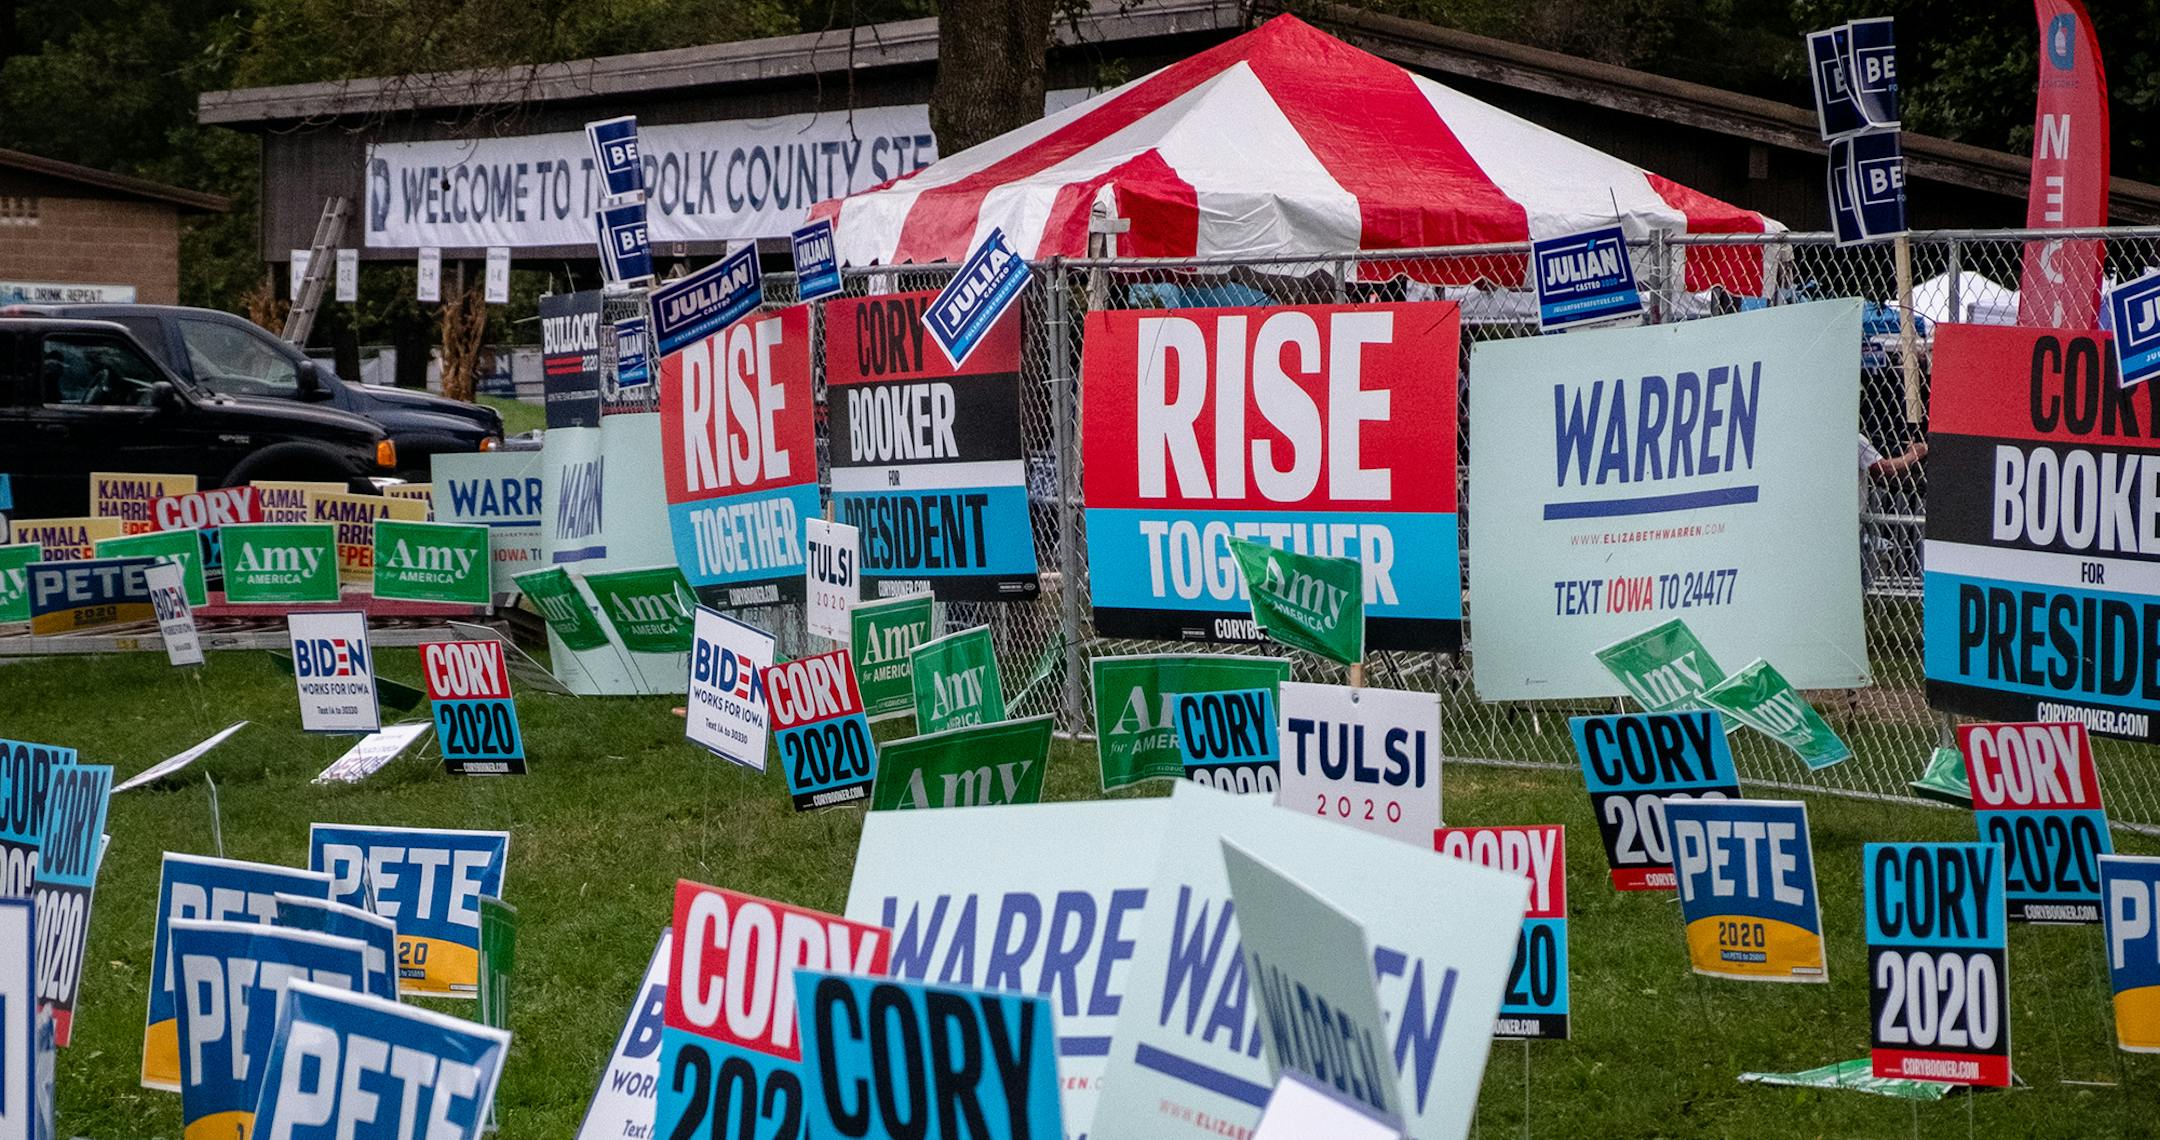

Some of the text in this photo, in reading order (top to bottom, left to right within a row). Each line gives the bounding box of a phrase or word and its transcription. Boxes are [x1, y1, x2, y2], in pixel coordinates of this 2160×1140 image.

[1866, 56, 1896, 83] BE
[611, 143, 638, 166] BE
[401, 163, 529, 225] WELCOME
[536, 159, 570, 221] TO
[642, 151, 715, 216] POLK
[726, 139, 860, 211] COUNTY
[872, 133, 934, 183] STE
[1869, 166, 1904, 194] BE
[620, 229, 648, 251] BE
[983, 266, 1010, 299] CASTRO
[1547, 239, 1620, 287] JULIÁN
[1575, 280, 1601, 292] CASTRO
[542, 312, 599, 355] BULLOCK
[856, 300, 928, 377] CORY
[582, 354, 598, 372] 2020
[680, 316, 792, 493] RISE
[849, 382, 960, 462] BOOKER
[1137, 310, 1394, 502] RISE
[1554, 361, 1762, 488] WARREN
[98, 479, 165, 500] KAMALA
[257, 489, 307, 509] KAMAL
[448, 477, 542, 518] WARR
[888, 469, 901, 487] FOR
[99, 501, 148, 521] HARRI
[157, 487, 253, 530] CORY
[1993, 445, 2160, 556] BOOKE
[18, 526, 89, 547] KAMALA
[690, 497, 803, 578] TOGETHER
[844, 493, 989, 571] PRESIDENT
[234, 541, 325, 577] Amy
[386, 538, 478, 580] Amy
[494, 548, 529, 562] IOWA
[808, 541, 853, 588] TULSI
[2081, 562, 2105, 585] FOR
[34, 564, 151, 607] PETE
[247, 573, 302, 585] AMERICA
[399, 572, 455, 585] AMERICA
[1258, 555, 1349, 630] Amy
[1554, 568, 1738, 616] TEXT IOWA TO 24477
[610, 591, 686, 626] Amy
[815, 593, 846, 612] 2020
[631, 624, 678, 636] AMERICA
[861, 621, 926, 666] Amy
[294, 638, 367, 678] BIDEN
[425, 643, 501, 698] CORY
[694, 636, 767, 707] BIDEN
[862, 662, 912, 685] for AMERICA
[301, 682, 370, 696] WORKS FOR IOWA
[693, 685, 765, 730] WORKS FOR IOWA
[767, 652, 853, 726] CORY
[930, 665, 987, 722] Amy
[440, 702, 516, 755] 2020
[705, 717, 717, 731] Text
[724, 727, 730, 737] to
[731, 729, 748, 745] 30330
[1109, 733, 1181, 757] for AMER
[1180, 691, 1269, 760] CORY
[784, 719, 871, 790] 2020
[1288, 716, 1427, 789] TULSI
[1584, 712, 1718, 787] CORY
[1968, 723, 2087, 806] CORY
[42, 767, 108, 876] CORY
[1316, 793, 1402, 824] 2020
[1603, 790, 1728, 865] 20
[1674, 819, 1806, 908] PETE
[1988, 814, 2099, 894] 2020
[322, 843, 494, 929] PETE
[1874, 845, 1995, 940] CORY
[2024, 903, 2099, 922] CORYBOOKER.COM
[882, 887, 1150, 1018] WARRE
[1718, 921, 1766, 948] 2020
[1876, 950, 1999, 1050] 2020
[270, 1019, 482, 1140] PETE
[814, 977, 1035, 1140] CORY
[1902, 1056, 1979, 1081] CORYBOOKER.COM
[611, 1069, 658, 1099] WOR
[622, 1119, 647, 1139] Text
